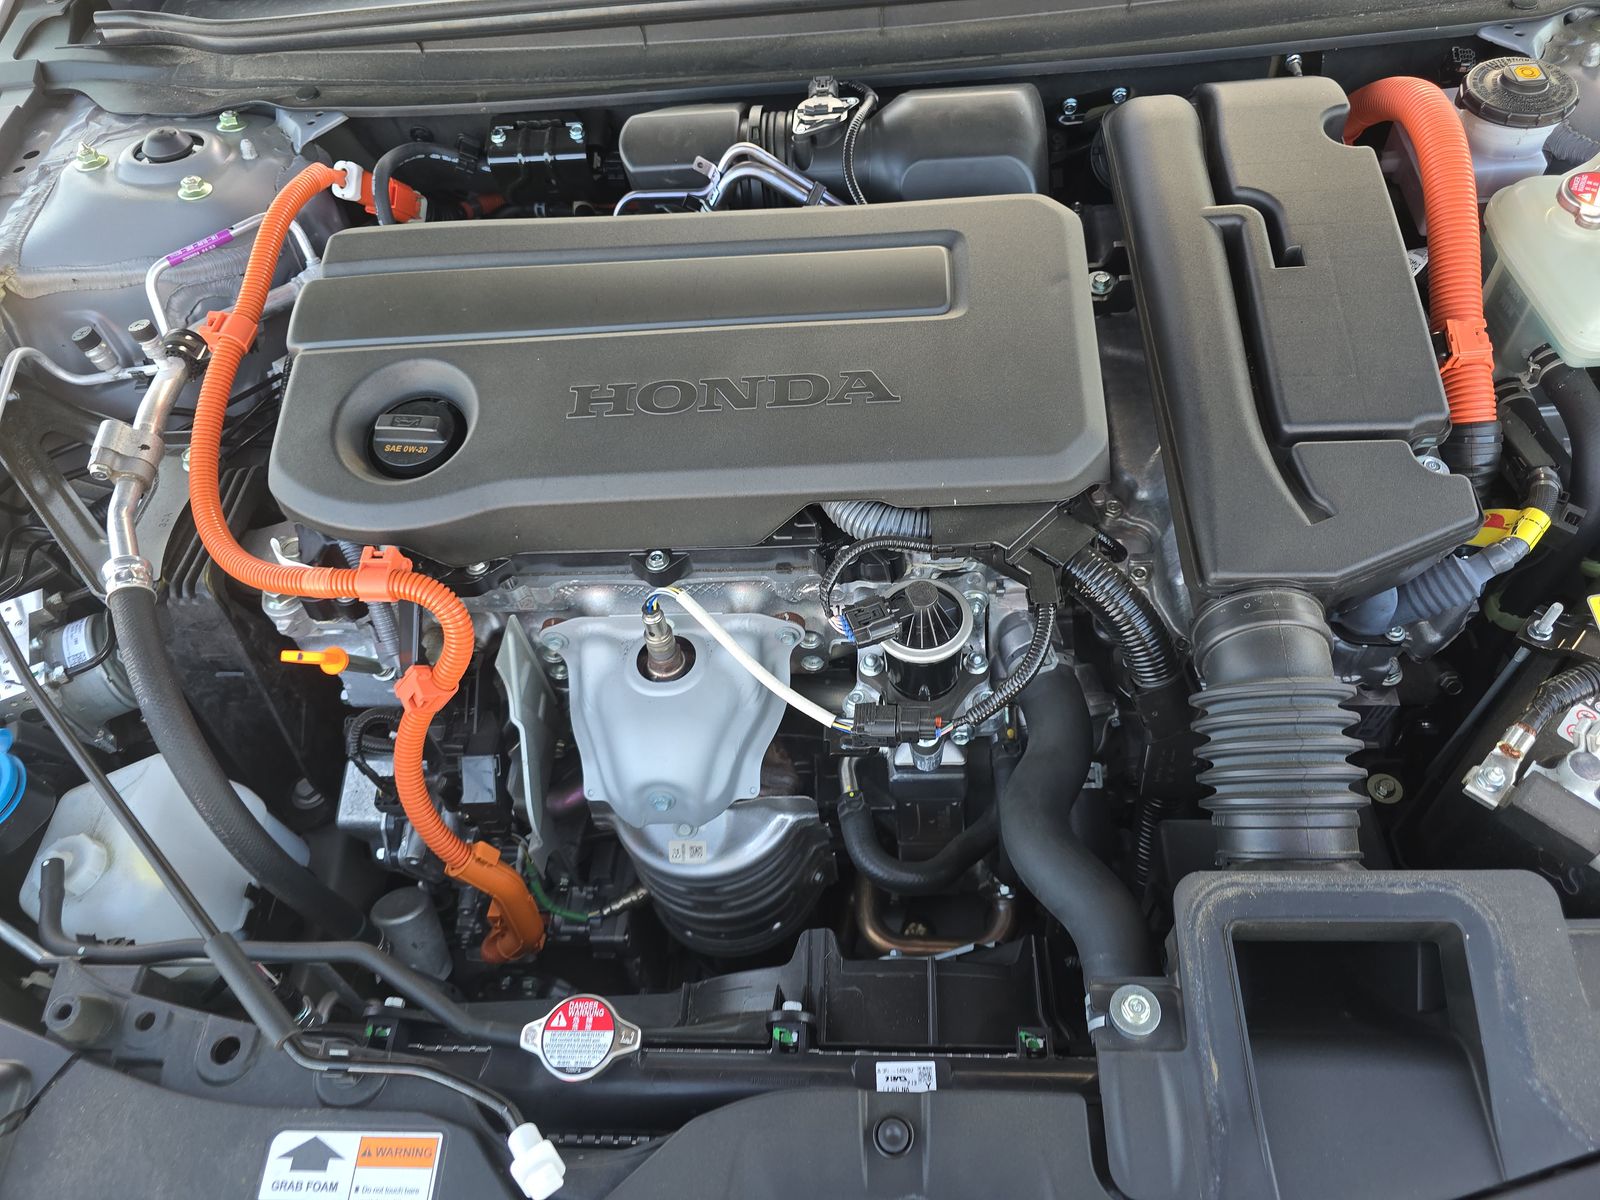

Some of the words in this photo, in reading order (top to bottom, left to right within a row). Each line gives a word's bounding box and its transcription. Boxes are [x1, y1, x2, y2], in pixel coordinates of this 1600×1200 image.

[566, 369, 901, 419] HONDA
[384, 444, 402, 453] SAE
[403, 444, 428, 454] 0W-20
[568, 1001, 599, 1010] DANGER
[376, 1147, 432, 1158] WARNING
[271, 1180, 303, 1193] GRAB
[305, 1181, 339, 1193] FOAM
